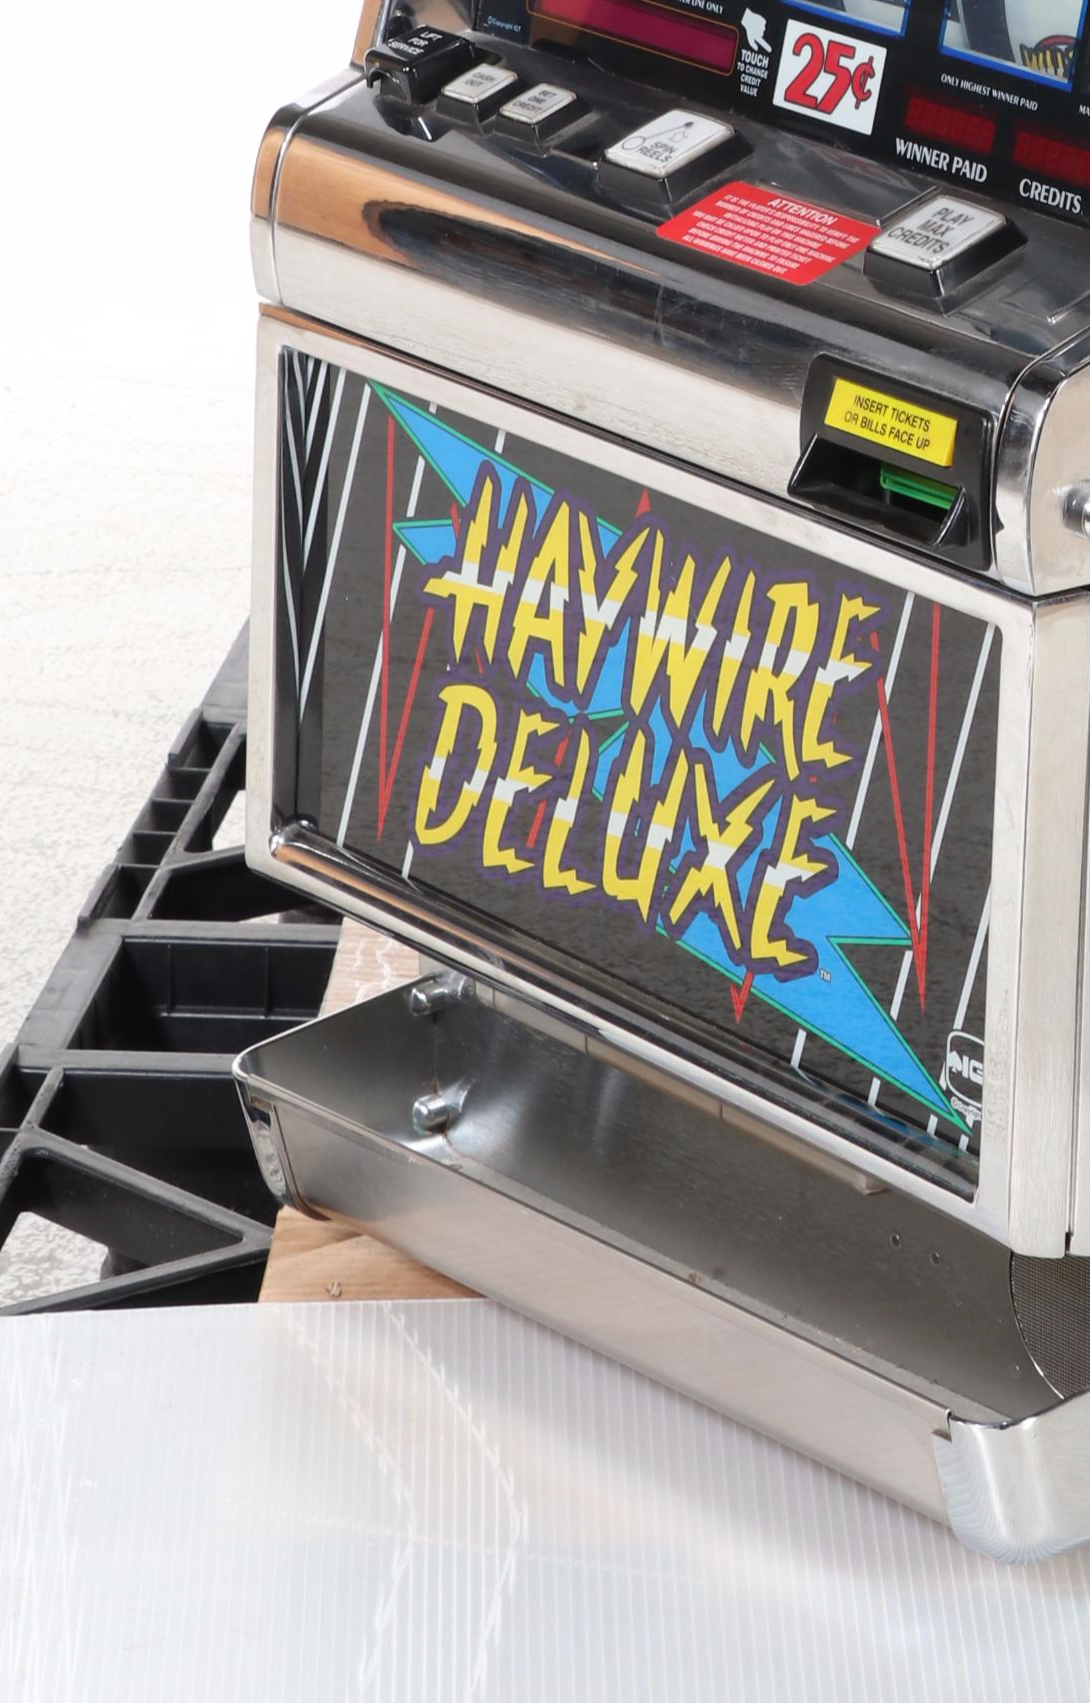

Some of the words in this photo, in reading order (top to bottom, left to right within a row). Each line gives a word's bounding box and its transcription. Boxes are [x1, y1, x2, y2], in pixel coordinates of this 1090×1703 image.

[706, 0, 724, 15] ONLY
[741, 49, 769, 67] TOUCH
[737, 61, 745, 70] TO
[745, 64, 769, 79] CHANGE
[740, 73, 761, 87] CREDIT
[784, 32, 876, 115] 25¢
[740, 84, 759, 97] VALUE
[941, 73, 959, 88] ONLY
[960, 79, 991, 97] HIGHEST
[992, 89, 1019, 106] WINNER
[1019, 98, 1039, 111] PAID
[637, 145, 672, 163] REELS
[649, 141, 678, 155] SPIN
[895, 137, 949, 171] WINNER
[951, 155, 988, 183] PAID
[1018, 178, 1082, 214] CREDITS
[767, 198, 838, 226] ATTENTION
[931, 207, 974, 226] PLAY
[917, 219, 955, 238] MAX
[888, 227, 950, 254] CREDITS
[853, 394, 888, 416] INSERT
[890, 407, 931, 433] TICKETS
[844, 410, 859, 425] OR
[860, 415, 888, 436] BILLS
[889, 427, 915, 446] FACE
[916, 437, 931, 451] UP
[422, 476, 882, 782] HAYWIRE
[413, 684, 838, 967] DELUXE
